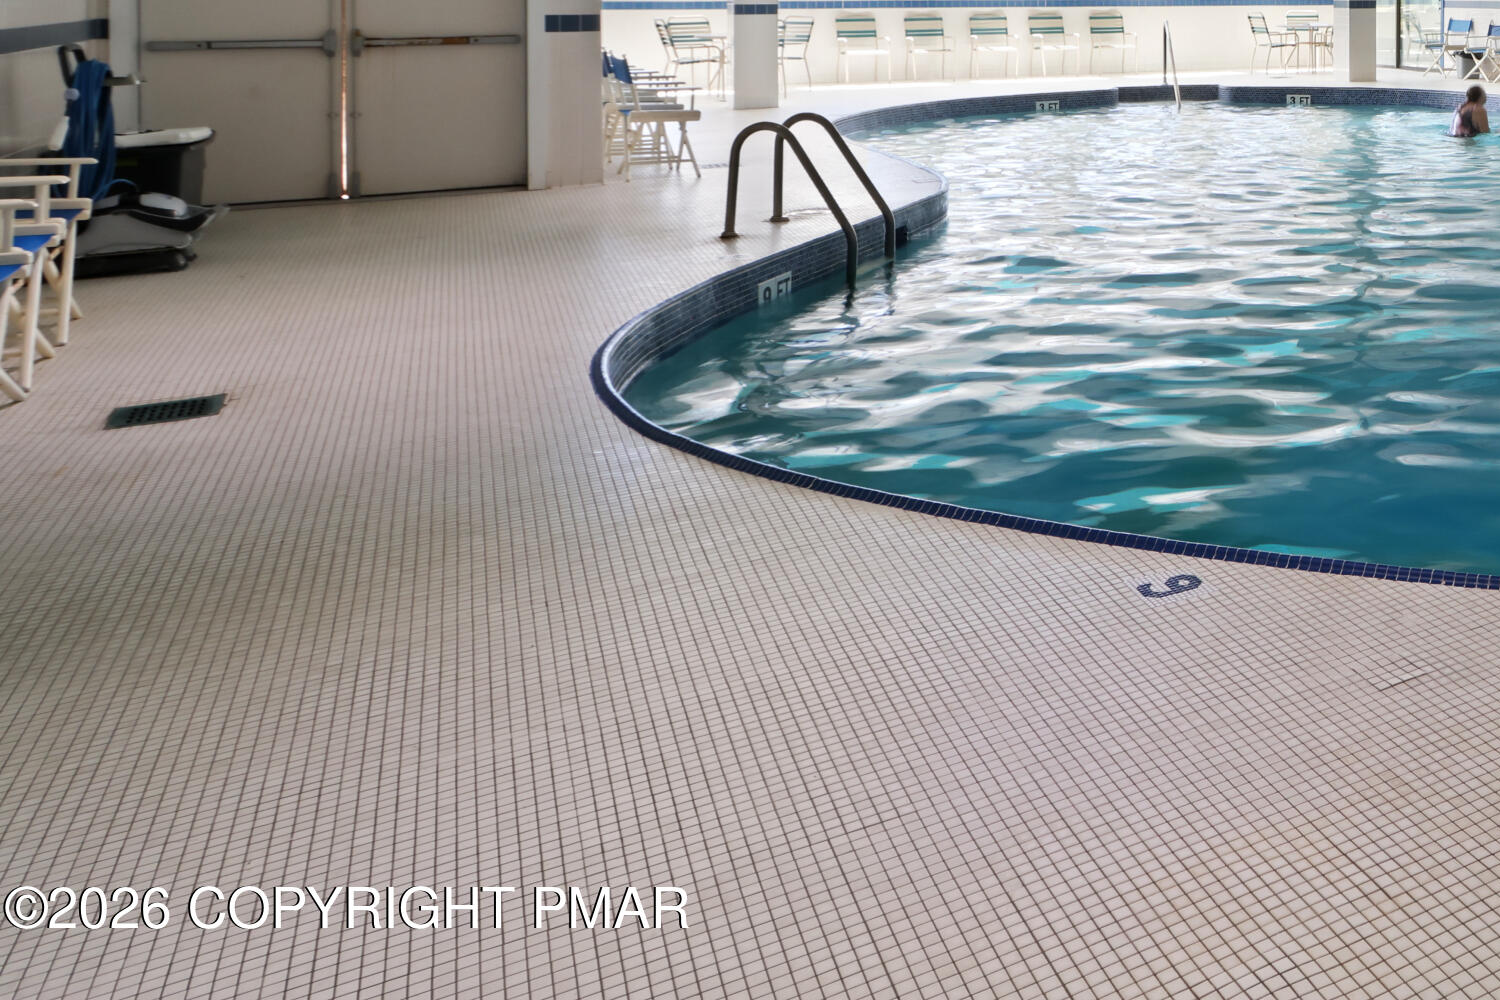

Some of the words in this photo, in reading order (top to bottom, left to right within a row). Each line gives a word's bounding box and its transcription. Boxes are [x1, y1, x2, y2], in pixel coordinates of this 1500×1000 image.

[1290, 96, 1296, 105] 3
[1300, 96, 1310, 105] FT
[1048, 102, 1058, 112] FT
[777, 277, 791, 297] FT
